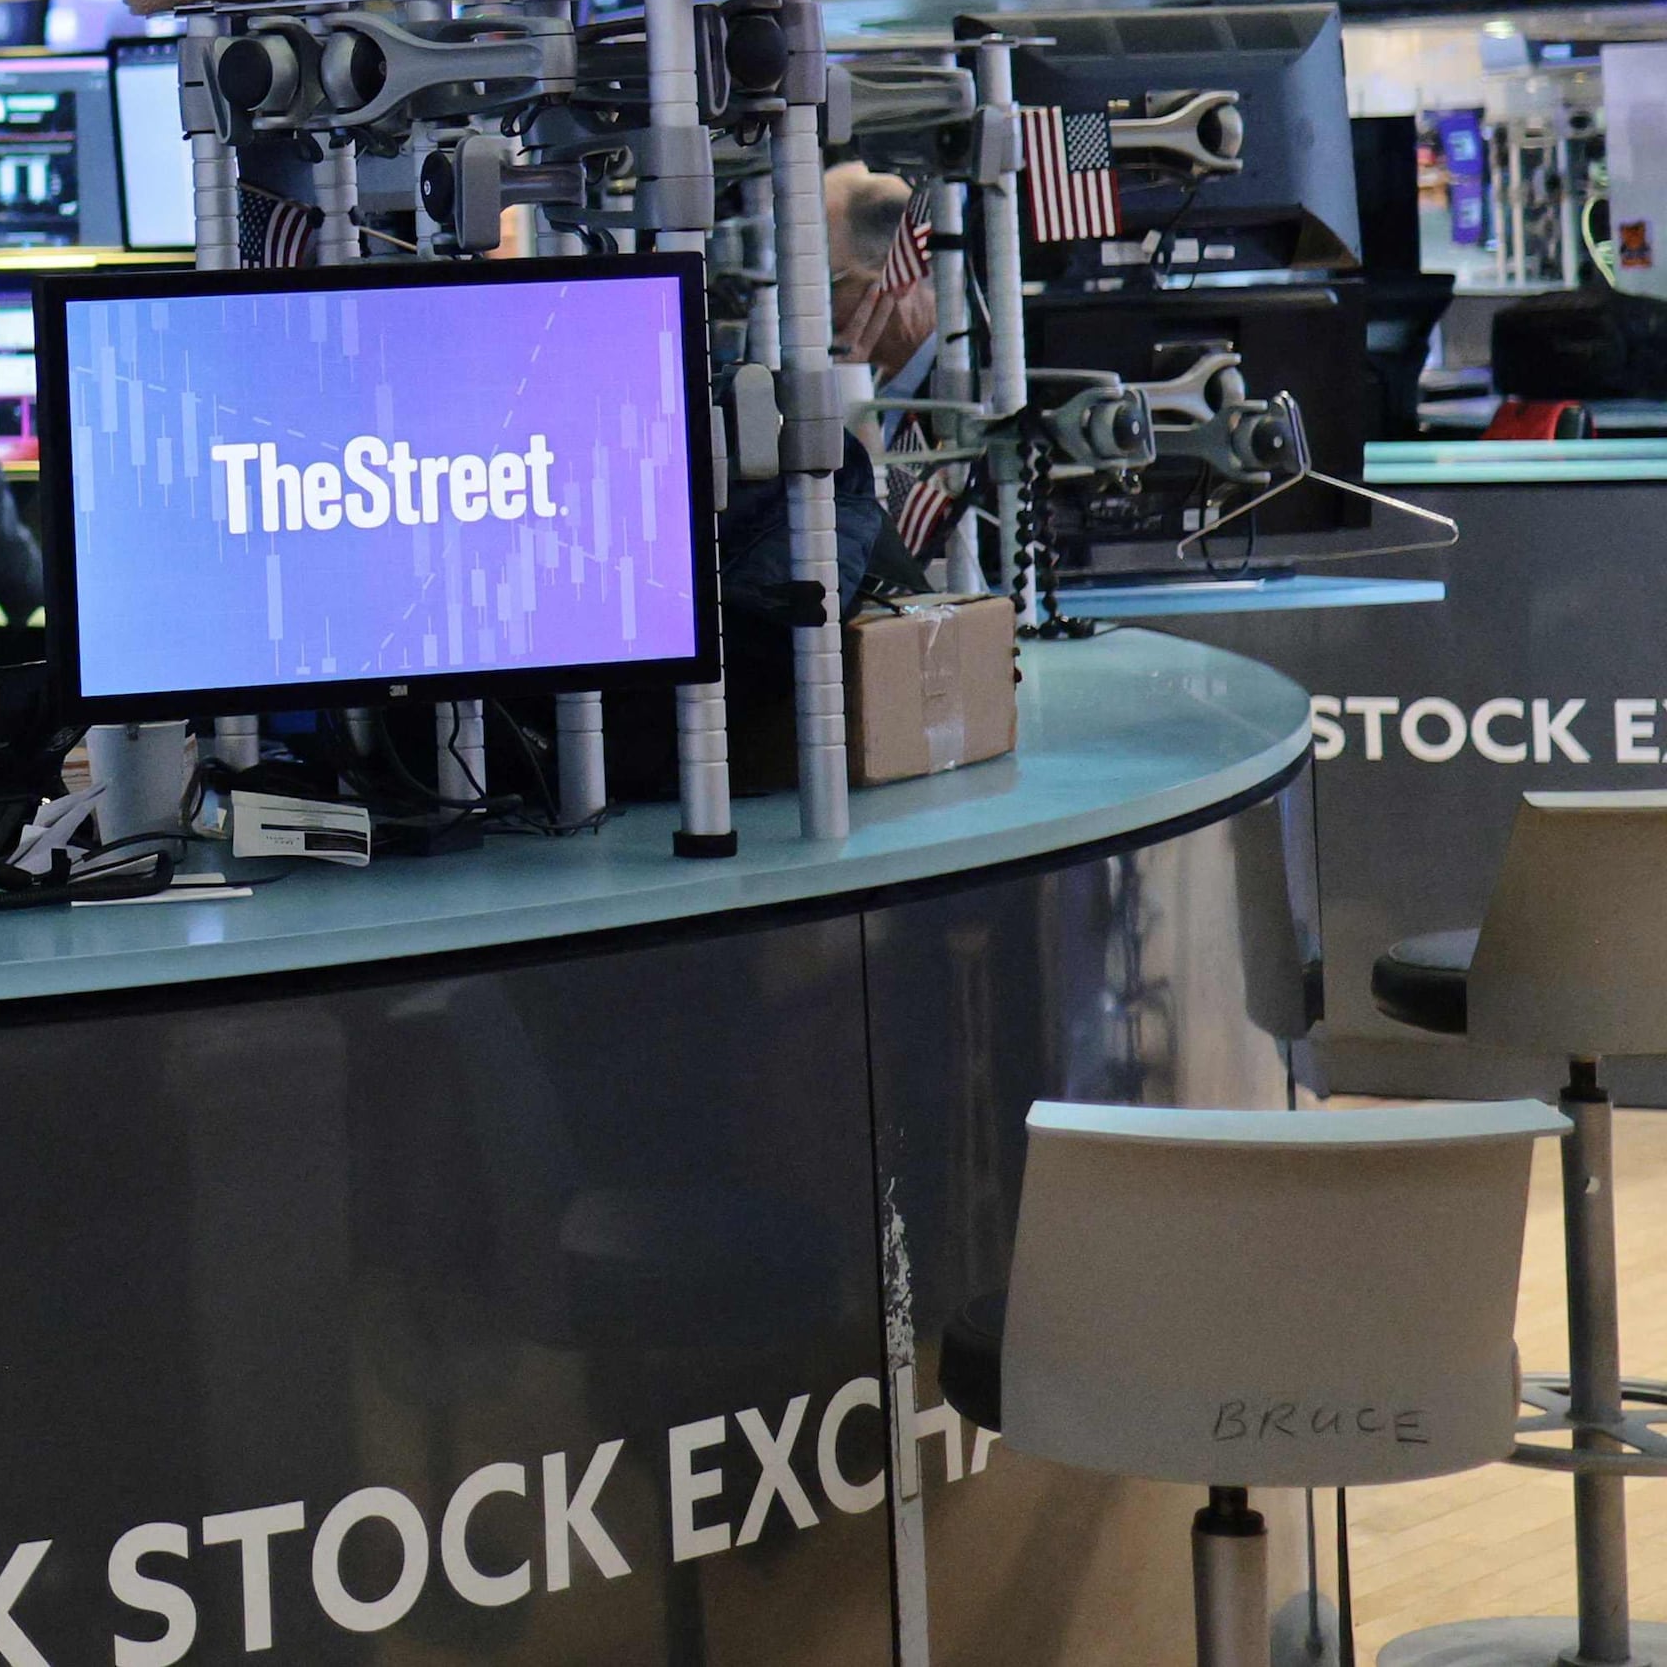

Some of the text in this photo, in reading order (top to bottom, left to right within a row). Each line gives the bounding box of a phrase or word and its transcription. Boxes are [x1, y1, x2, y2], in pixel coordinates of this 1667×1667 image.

[1312, 696, 1667, 764] STOCK E
[1213, 1401, 1431, 1444] BRUCE
[107, 1440, 631, 1667] STOCK
[668, 1376, 1004, 1564] EXCH
